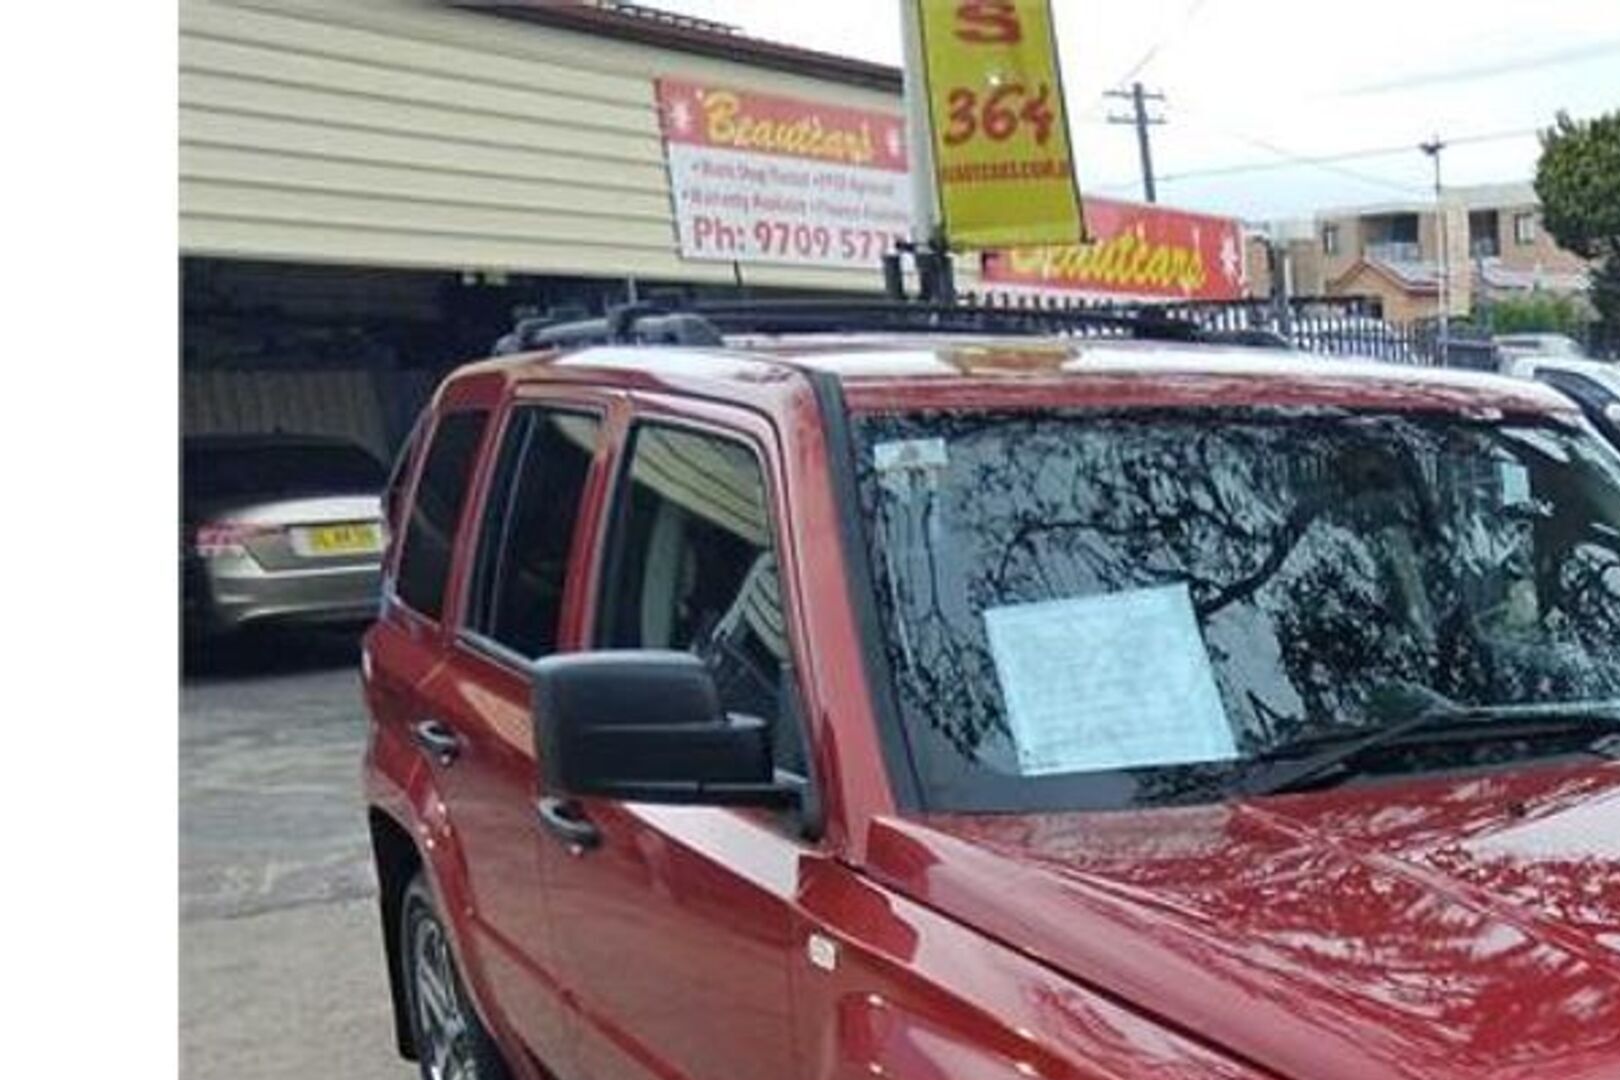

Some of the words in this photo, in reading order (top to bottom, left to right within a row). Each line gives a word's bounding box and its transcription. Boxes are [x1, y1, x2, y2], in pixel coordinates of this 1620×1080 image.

[943, 83, 1053, 146] 364
[693, 215, 745, 251] Ph:
[754, 220, 830, 257] 9709
